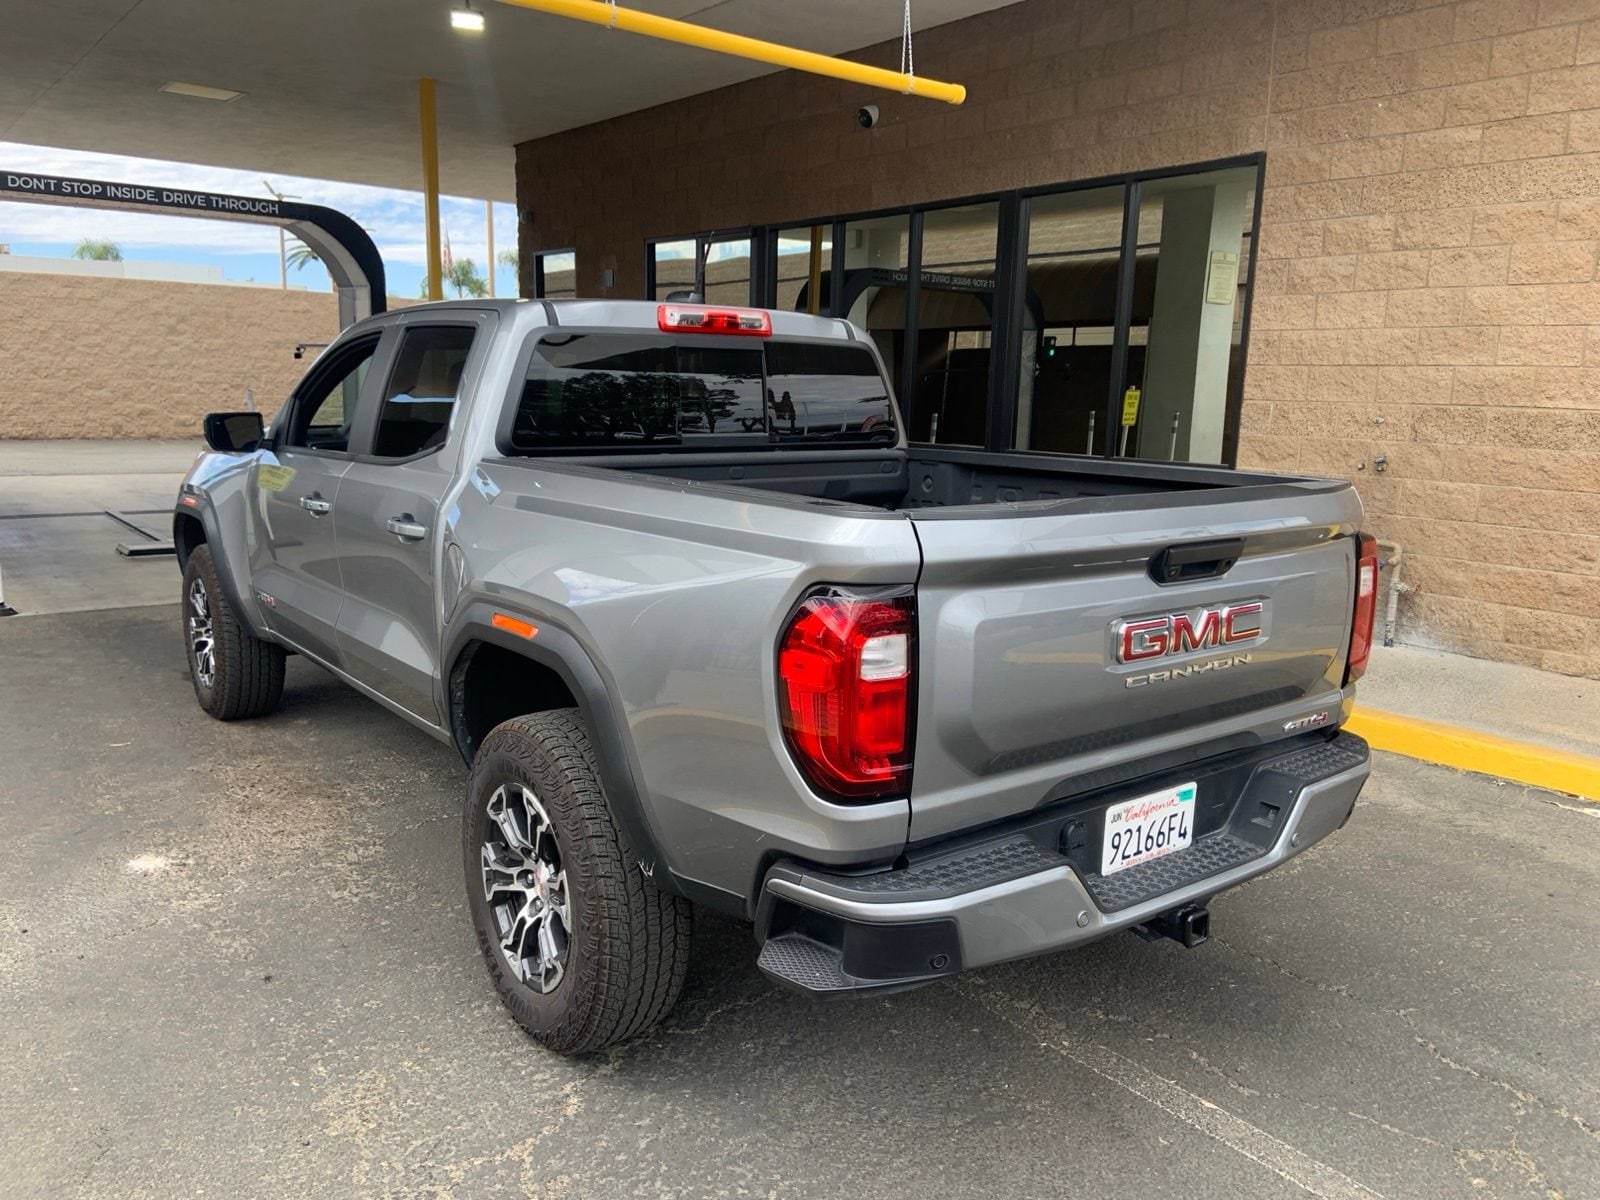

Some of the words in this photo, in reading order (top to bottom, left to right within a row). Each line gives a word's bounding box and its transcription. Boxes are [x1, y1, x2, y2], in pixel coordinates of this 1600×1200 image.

[7, 174, 57, 191] DON'T
[61, 180, 102, 196] STOP
[163, 191, 207, 207] DRIVE
[209, 196, 279, 215] THROUGH
[1119, 602, 1263, 664] GMC
[1125, 653, 1252, 689] CANYON
[1123, 801, 1179, 822] California
[1109, 810, 1188, 865] 92166F4
